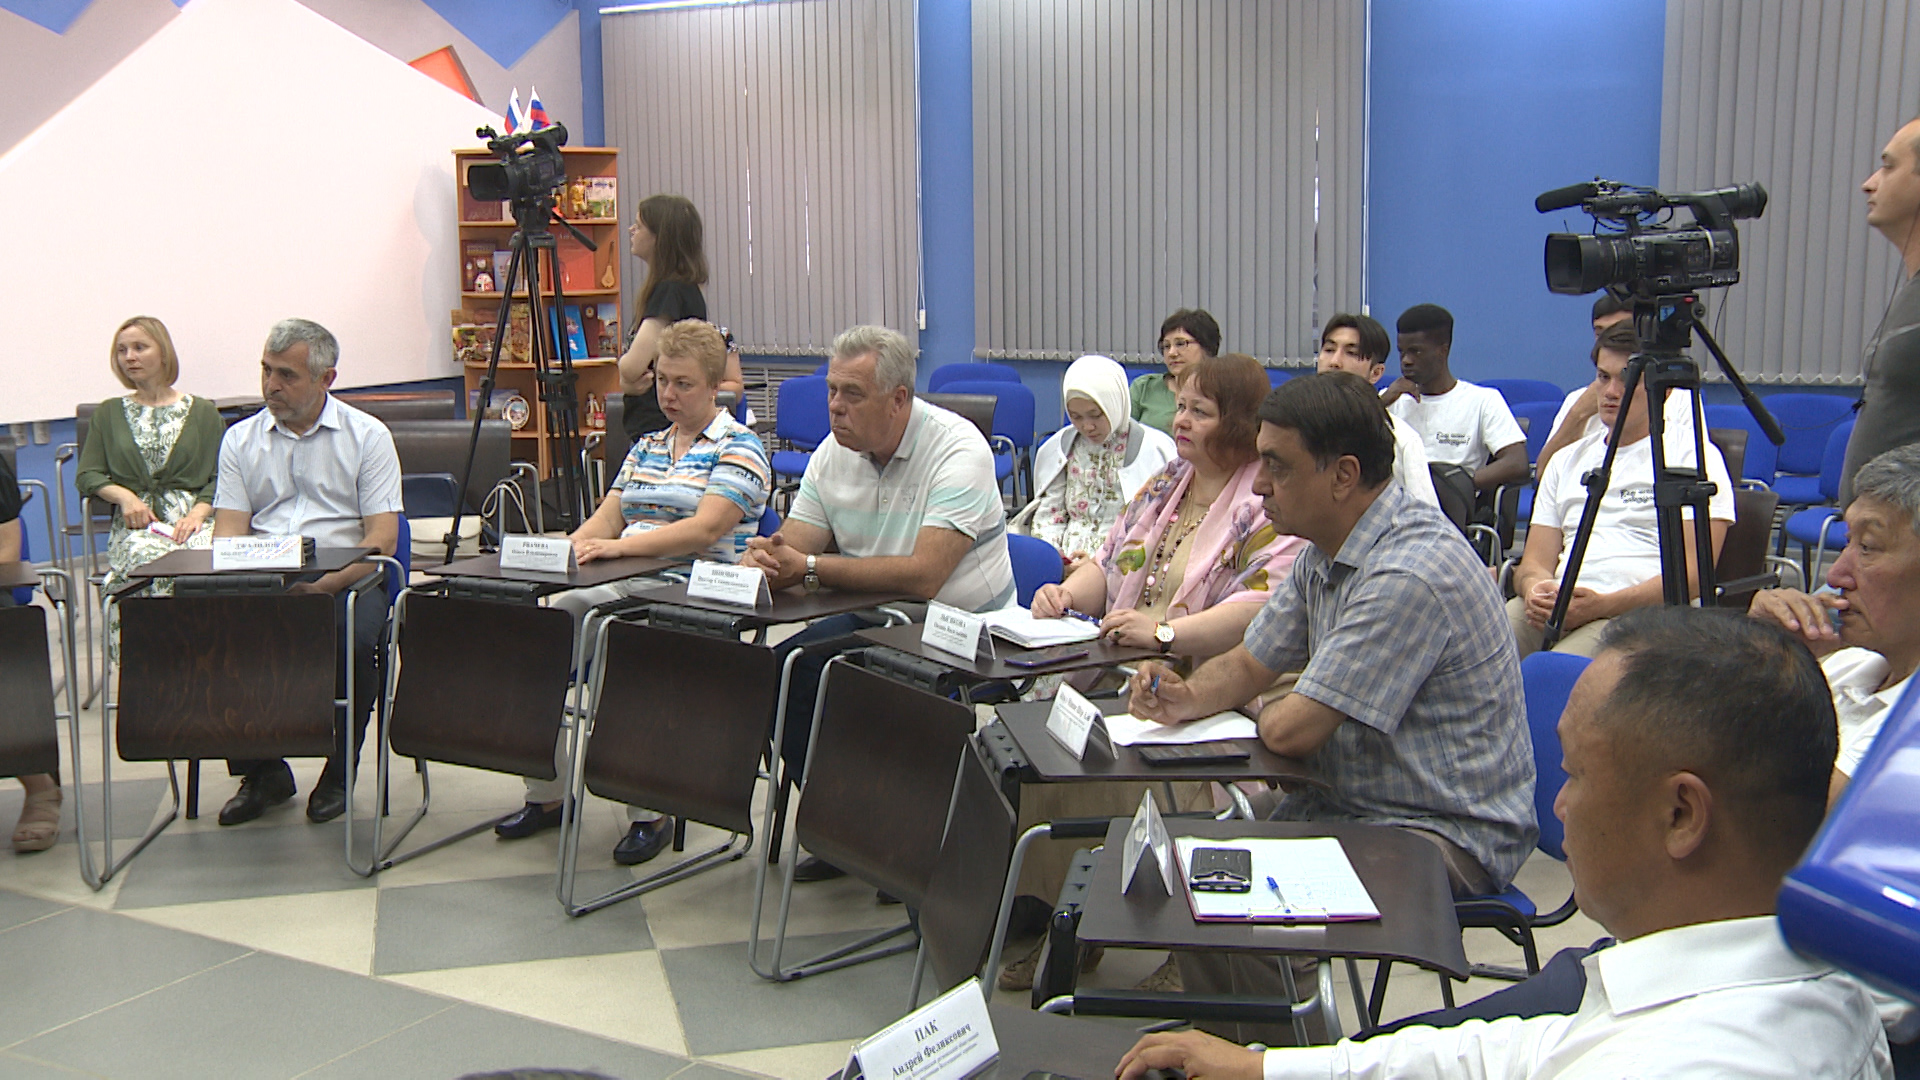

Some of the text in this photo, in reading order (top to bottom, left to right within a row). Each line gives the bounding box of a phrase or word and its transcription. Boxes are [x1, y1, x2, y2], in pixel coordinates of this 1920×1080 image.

[914, 1019, 939, 1042] ПАК
[892, 1051, 924, 1078] Андрей
[923, 1023, 972, 1057] Феликсович
